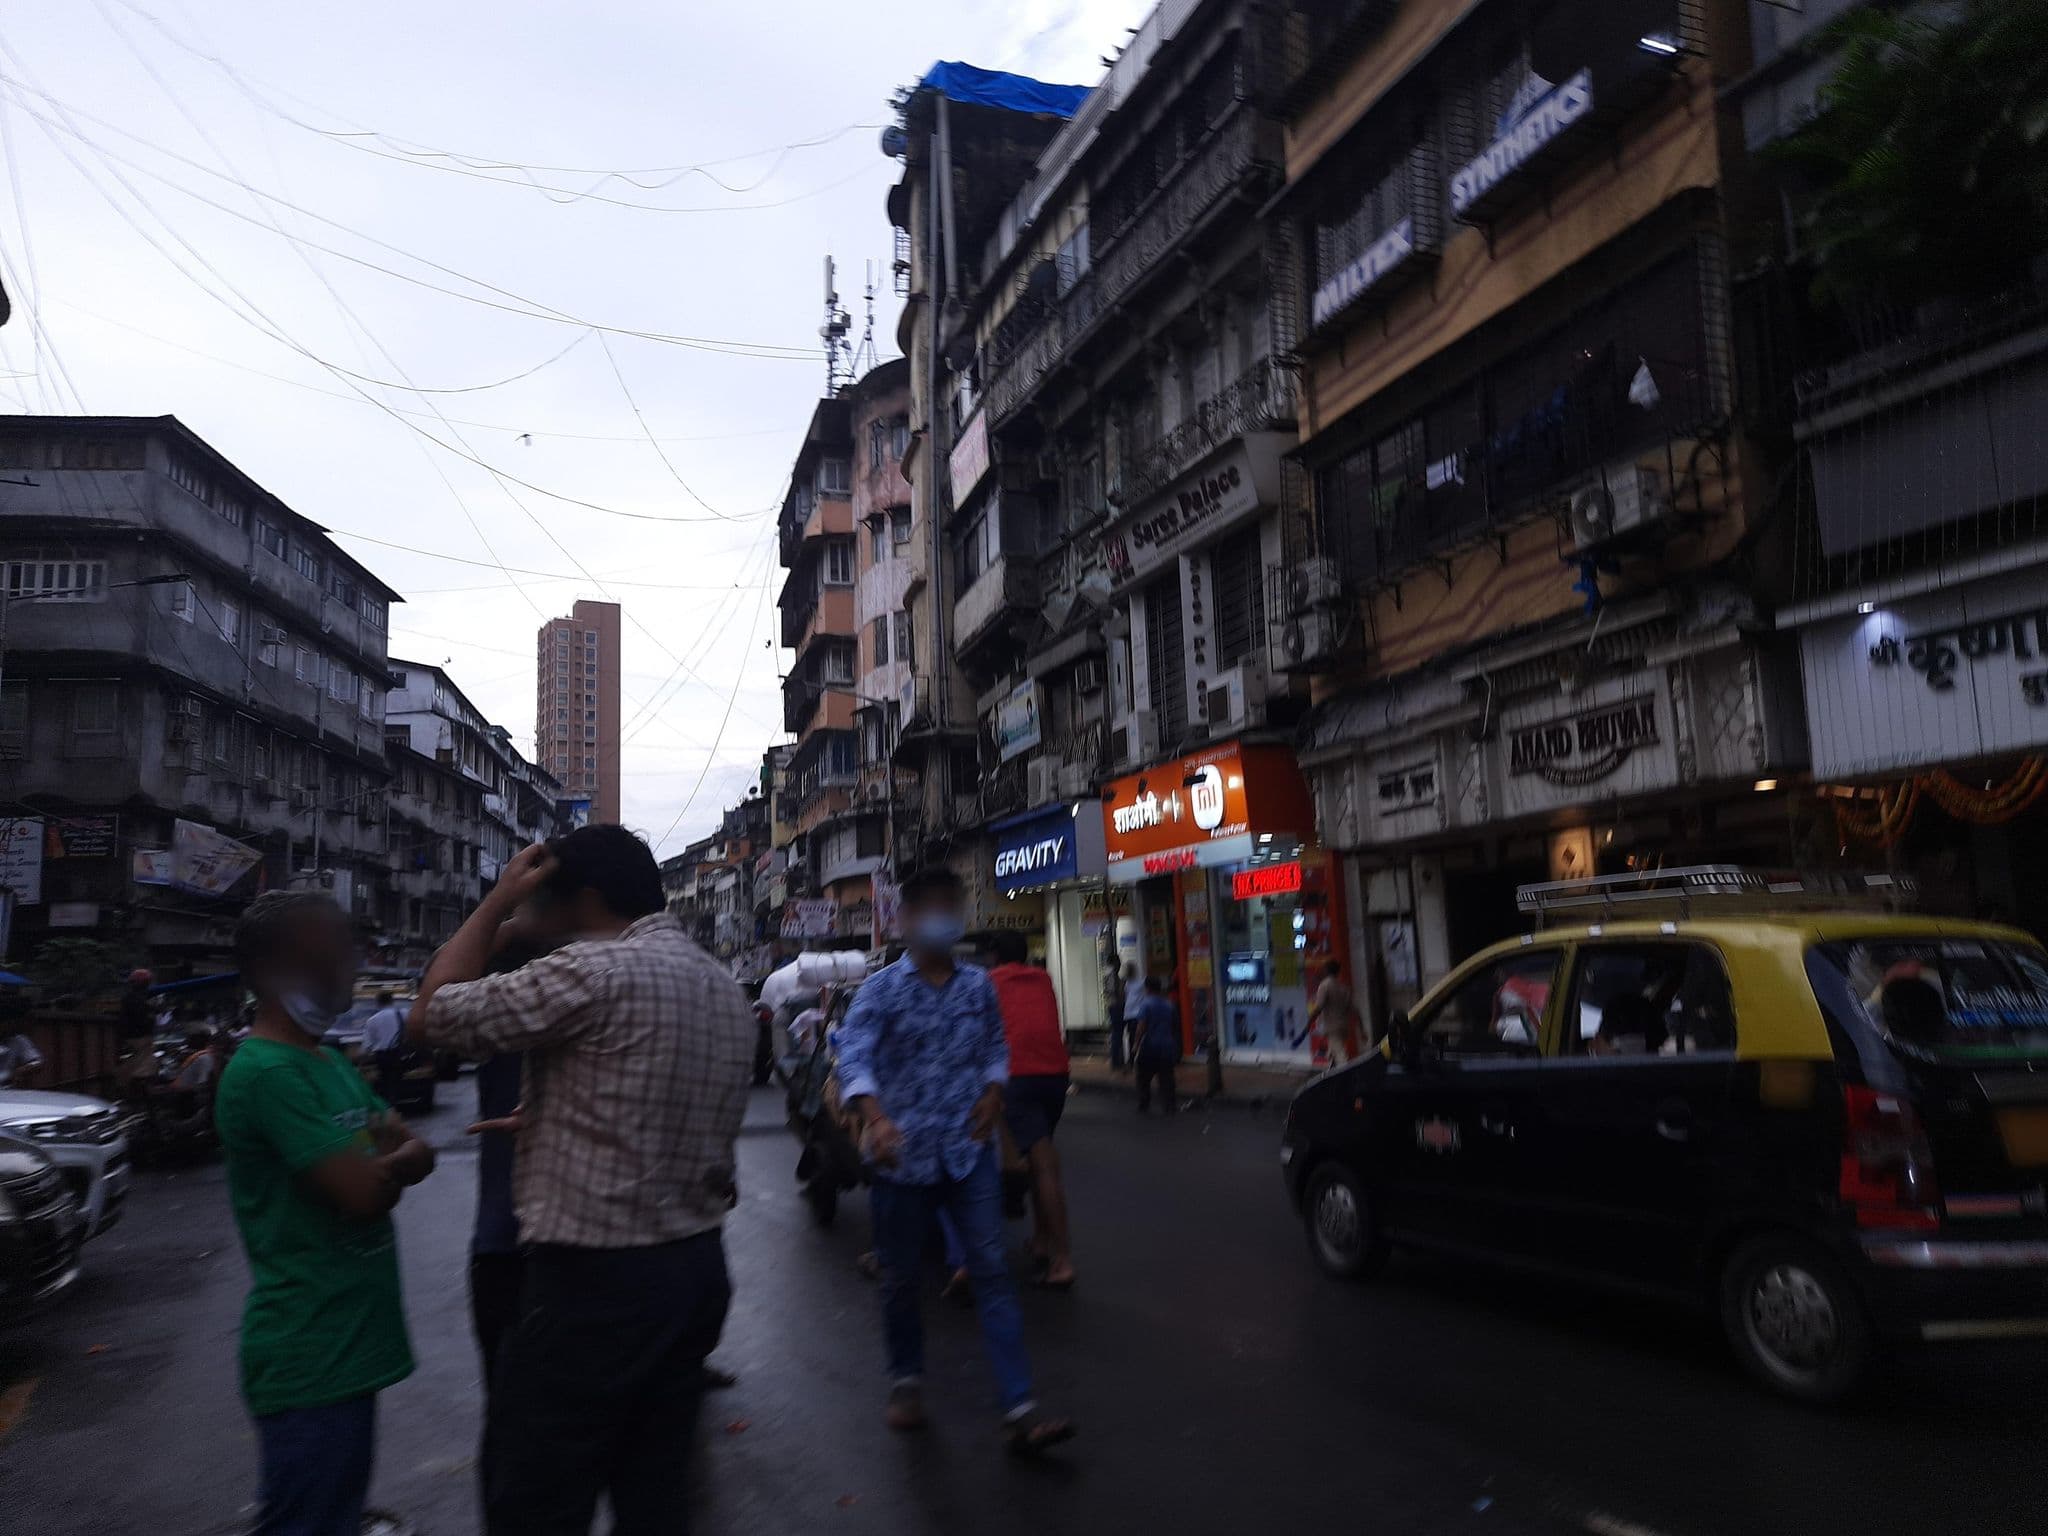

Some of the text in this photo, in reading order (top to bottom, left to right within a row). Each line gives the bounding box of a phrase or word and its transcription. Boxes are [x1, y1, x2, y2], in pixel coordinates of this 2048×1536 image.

[1452, 84, 1592, 213] SYNTHETICS
[1131, 507, 1179, 550] Saree
[1177, 465, 1242, 519] Palace
[995, 835, 1065, 878] GRAVITY
